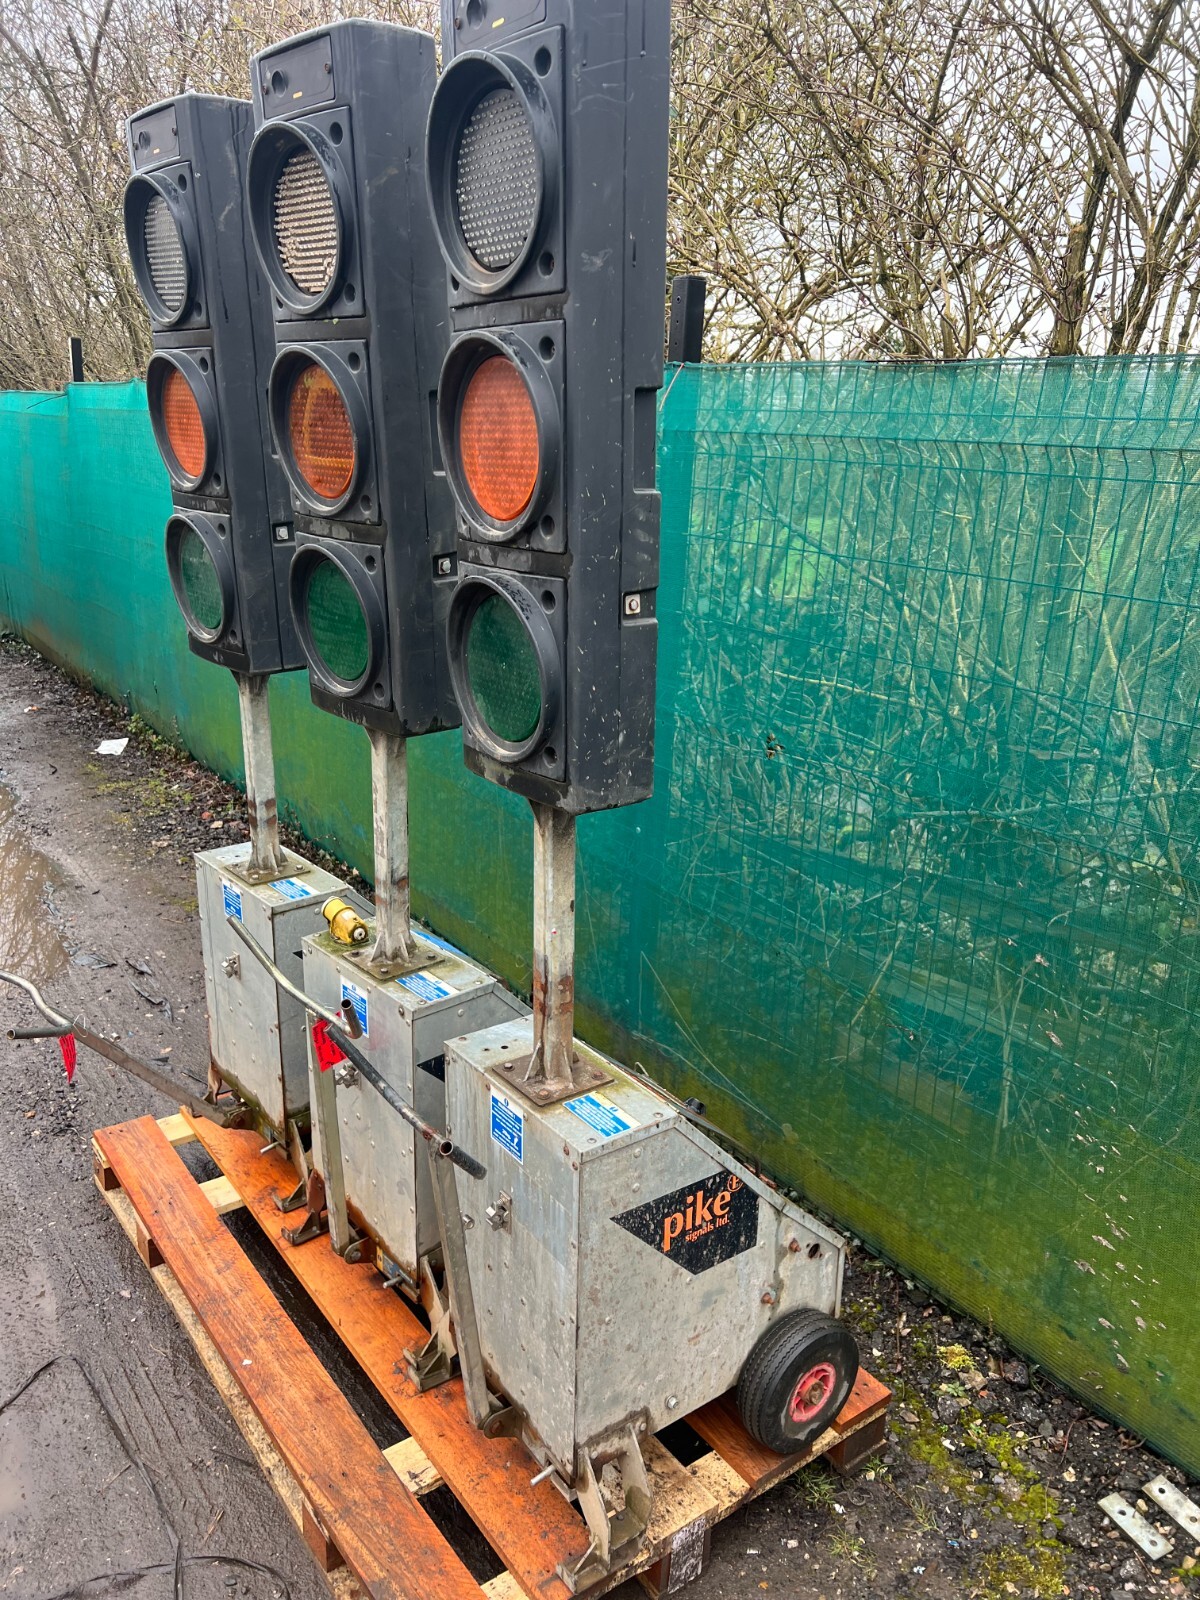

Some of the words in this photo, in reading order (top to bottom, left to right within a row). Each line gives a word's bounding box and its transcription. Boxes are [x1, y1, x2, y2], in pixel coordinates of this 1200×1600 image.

[662, 1190, 731, 1253] pike
[685, 1222, 714, 1242] signals
[716, 1214, 730, 1228] ltd.
